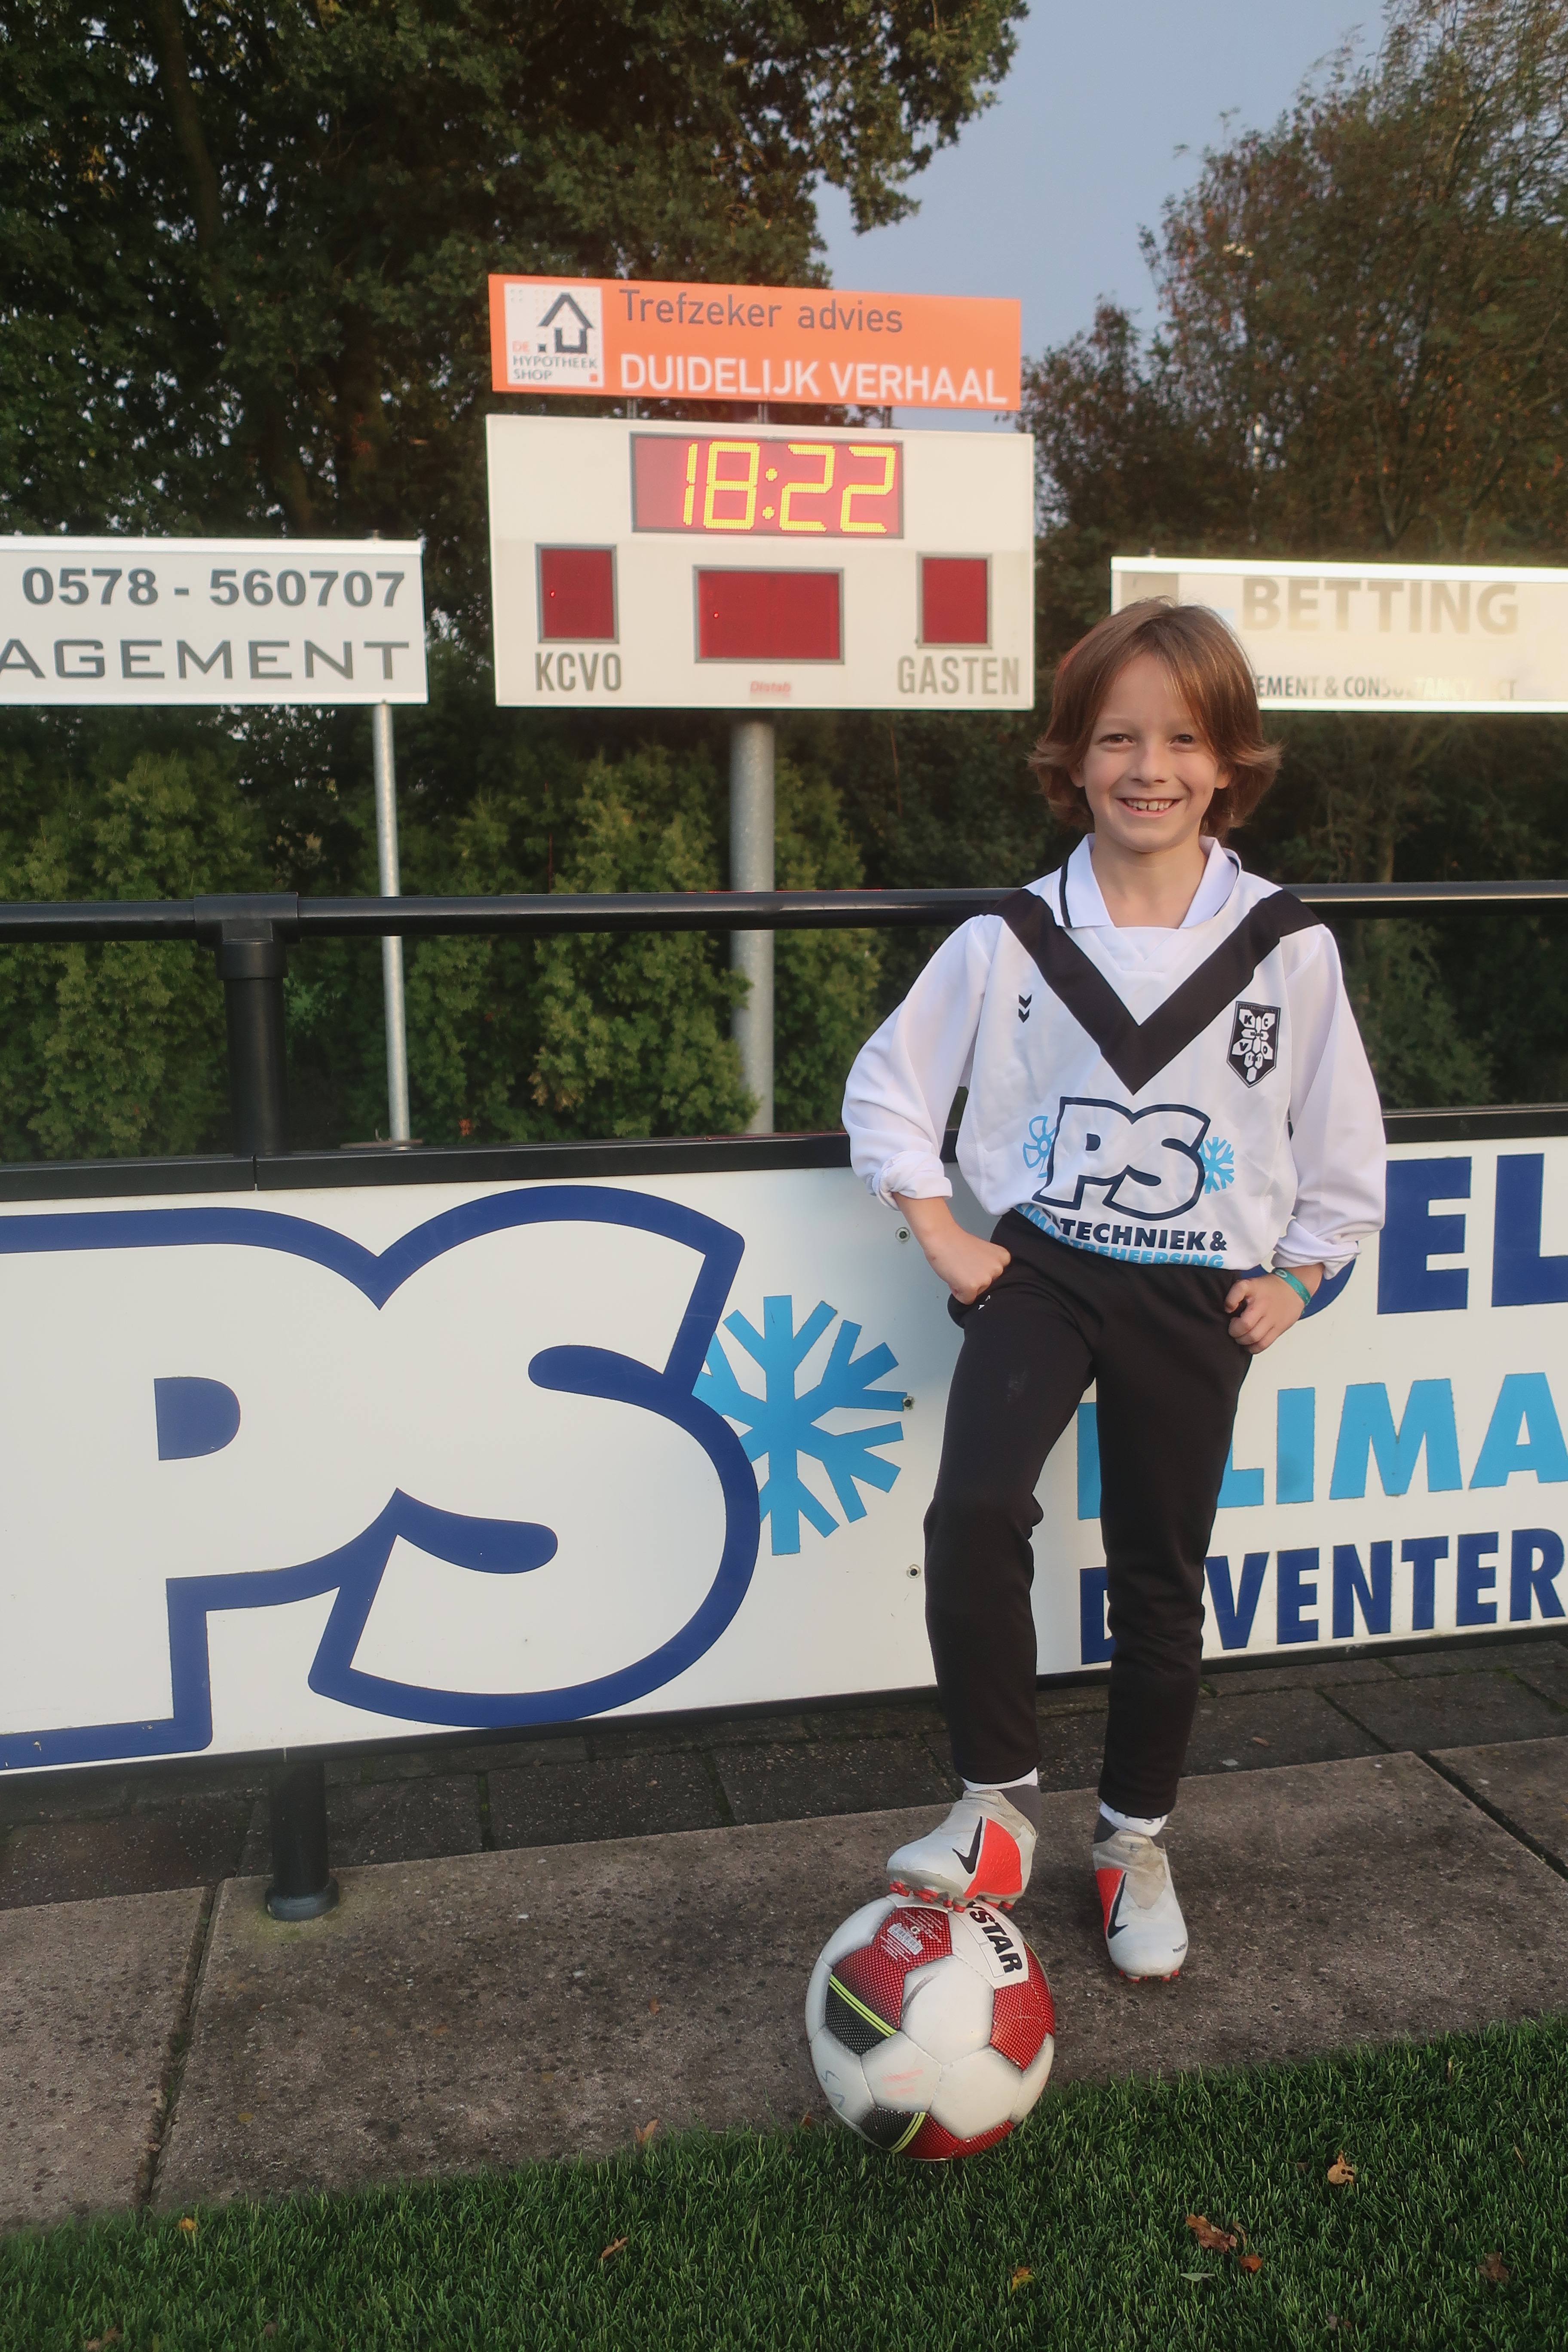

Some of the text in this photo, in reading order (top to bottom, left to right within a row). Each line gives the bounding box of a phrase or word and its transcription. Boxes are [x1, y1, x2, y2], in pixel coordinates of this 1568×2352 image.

[619, 288, 903, 333] Trefzeker advies
[513, 355, 597, 368] HYPOTHEEK
[514, 369, 552, 380] SHOP
[620, 353, 1008, 404] DUIDELIJK VERHAAL
[683, 441, 896, 533] 18:22
[22, 567, 159, 606] 0578
[210, 569, 405, 607] 560707
[1243, 578, 1518, 634] BETTING
[0, 639, 409, 680] AGEMENT
[535, 652, 622, 692] KCVO
[897, 656, 1019, 695] GASTEN
[1325, 676, 1338, 696] &
[1032, 1096, 1211, 1222] PS
[1210, 1231, 1228, 1251] &
[0, 1185, 761, 1770] PS
[1080, 1528, 1565, 1665] VENTER
